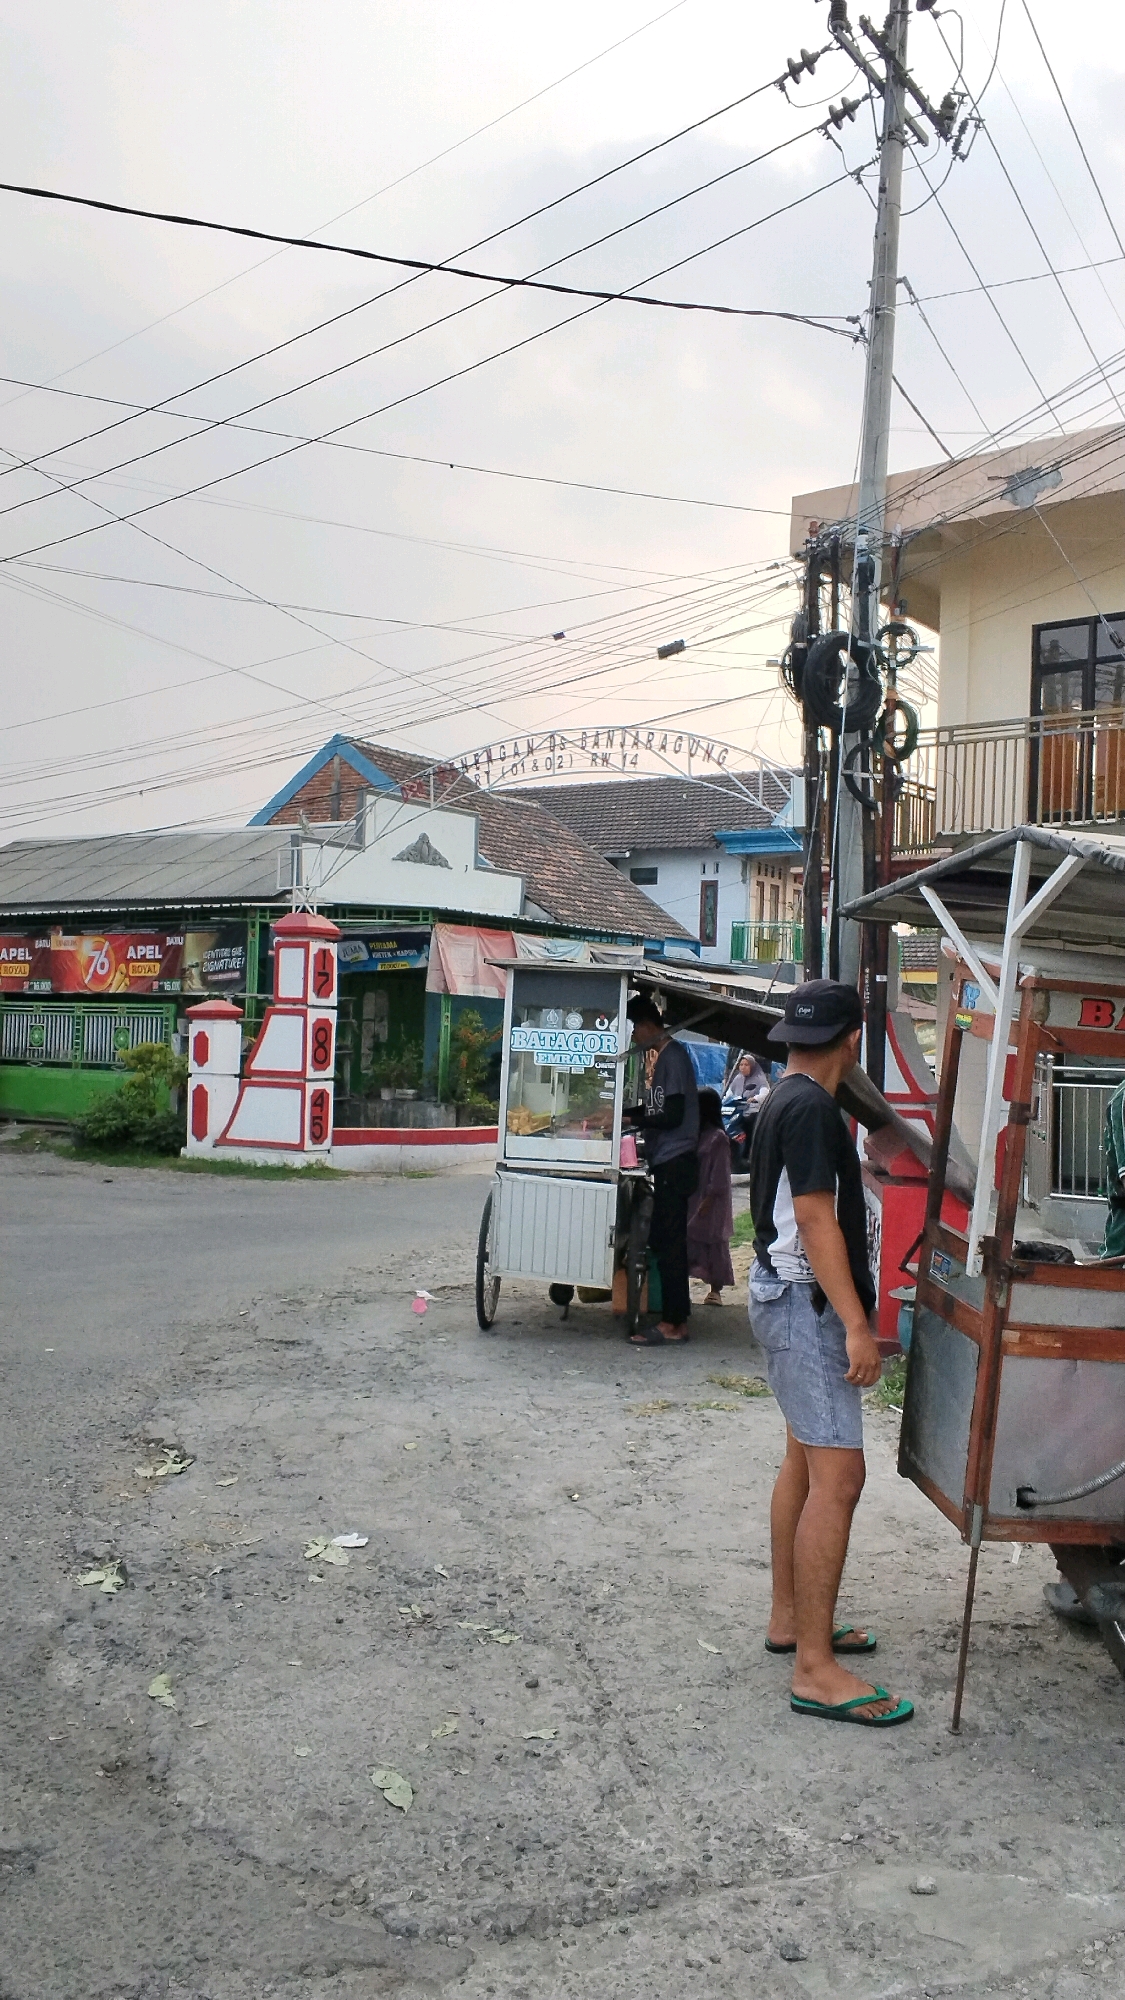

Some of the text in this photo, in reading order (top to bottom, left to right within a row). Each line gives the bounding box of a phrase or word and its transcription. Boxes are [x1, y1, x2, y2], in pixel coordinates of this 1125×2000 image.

[580, 729, 729, 766] BANJARAGUNG
[0, 947, 33, 961] APEL
[127, 945, 163, 960] APEL
[3, 965, 28, 975] ROYAL
[84, 940, 110, 985] 76
[132, 964, 157, 974] ROYAL
[314, 1027, 329, 1065] 8
[511, 1030, 618, 1055] BATAGOR
[536, 1051, 592, 1066] EMRAN
